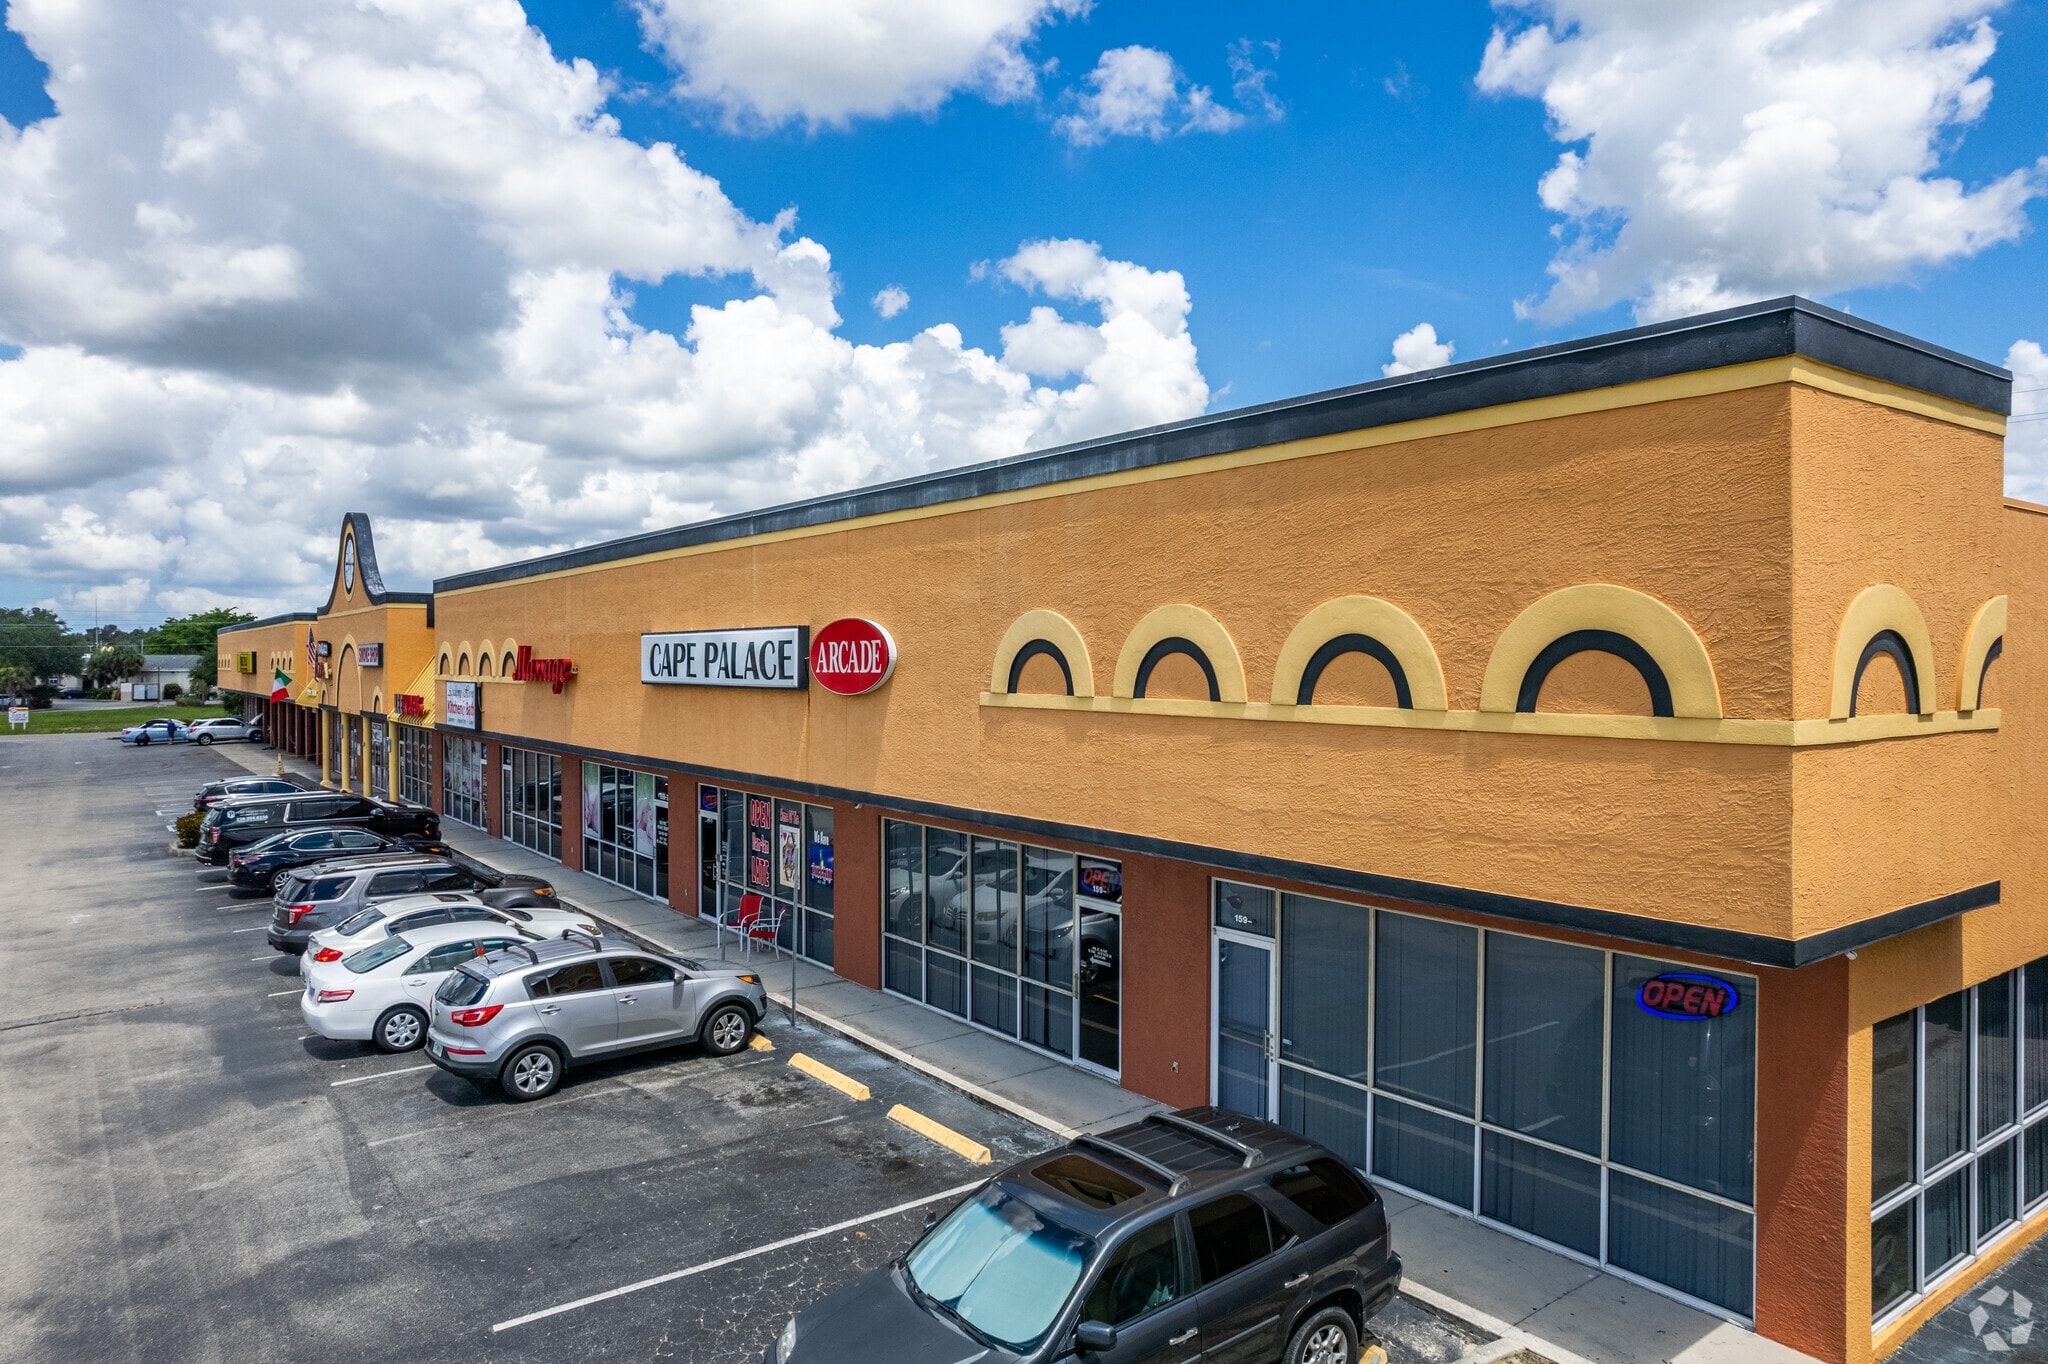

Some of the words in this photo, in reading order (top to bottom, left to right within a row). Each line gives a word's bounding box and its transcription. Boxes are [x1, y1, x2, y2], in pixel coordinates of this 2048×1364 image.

[650, 642, 697, 678] CAPE
[704, 639, 794, 680] PALACE
[816, 639, 882, 674] ARCADE
[750, 798, 771, 830] OPEN
[751, 855, 770, 887] LATE
[1083, 868, 1119, 892] OPEN
[1642, 980, 1726, 1017] OPEN
